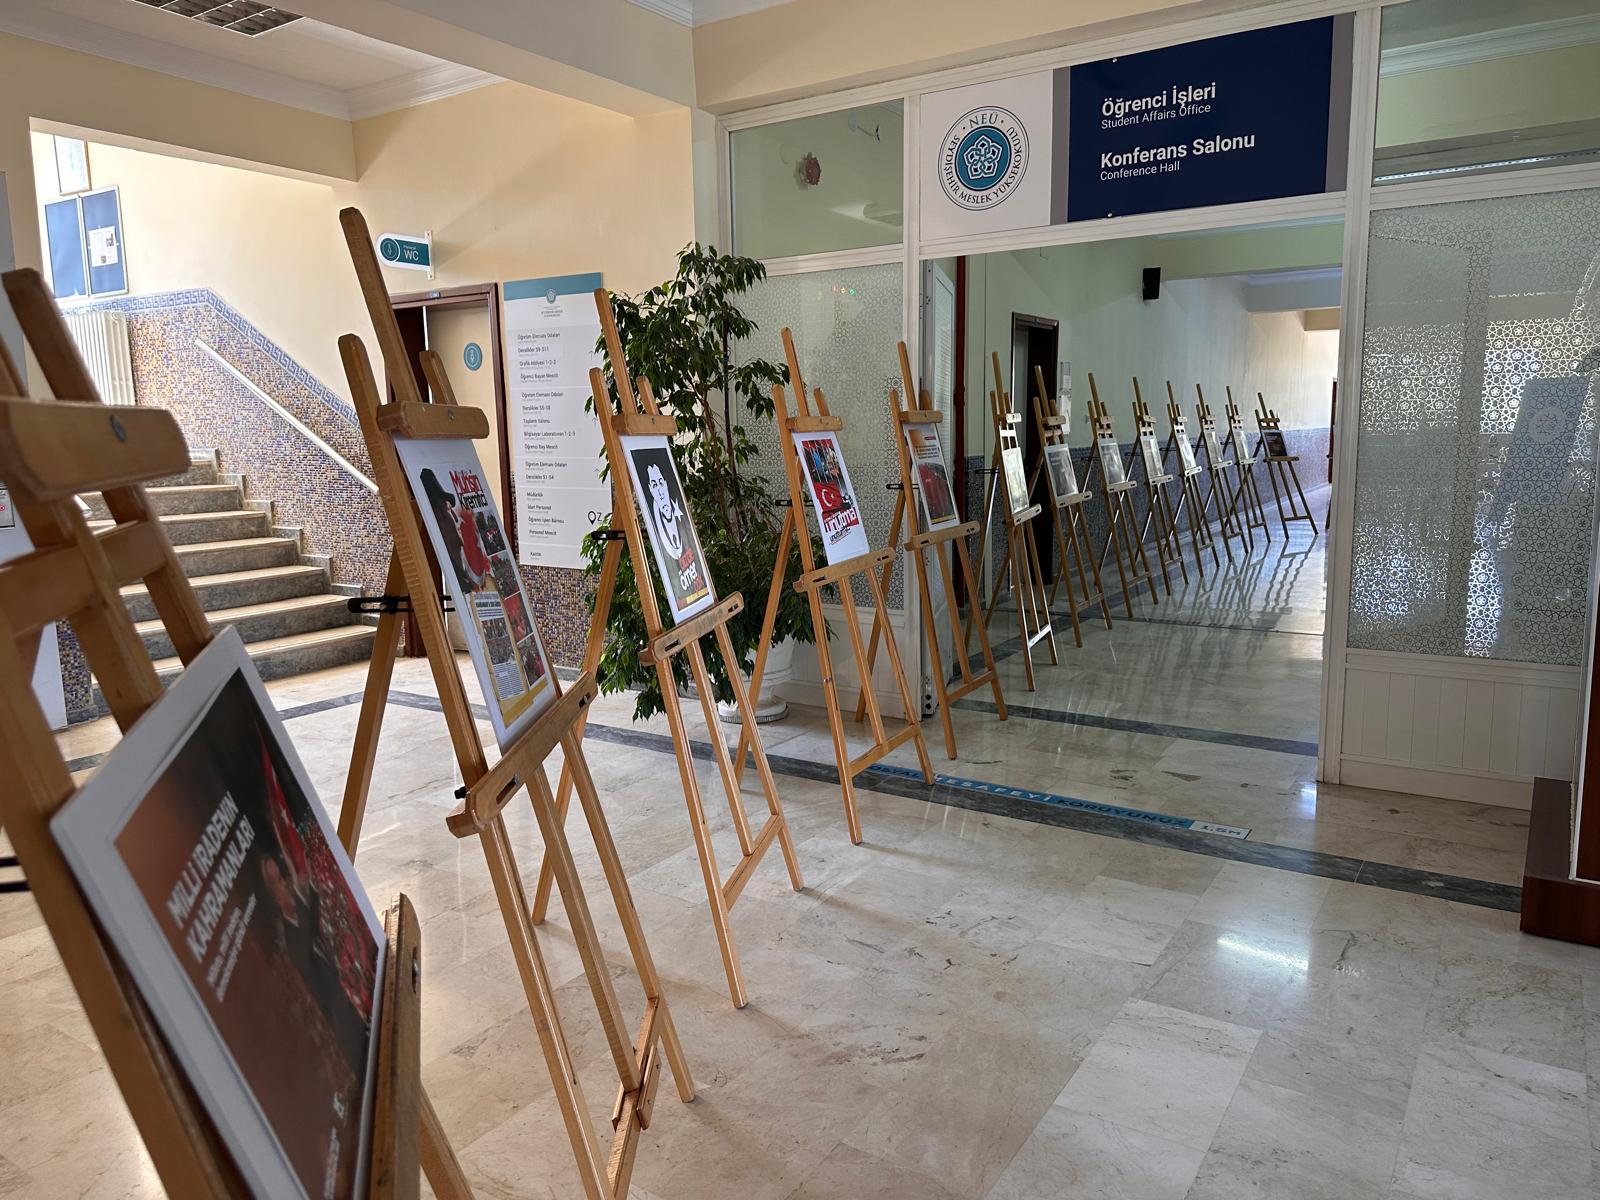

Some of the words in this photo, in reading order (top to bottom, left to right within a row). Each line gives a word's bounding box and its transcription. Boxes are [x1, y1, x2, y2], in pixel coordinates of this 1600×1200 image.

[1102, 91, 1167, 118] Öğrenci
[1172, 82, 1216, 108] İşleri
[969, 111, 998, 128] NEÜ
[1101, 114, 1140, 129] Student
[1142, 109, 1176, 123] Affairs
[1179, 104, 1212, 117] Office
[1101, 144, 1187, 169] Konferans
[1193, 134, 1255, 155] Salonu
[1100, 165, 1157, 181] Conference
[1160, 160, 1180, 173] Hall
[959, 190, 993, 204] MESLEK
[403, 248, 419, 261] WC
[186, 815, 255, 964] KAHRAMANLARI
